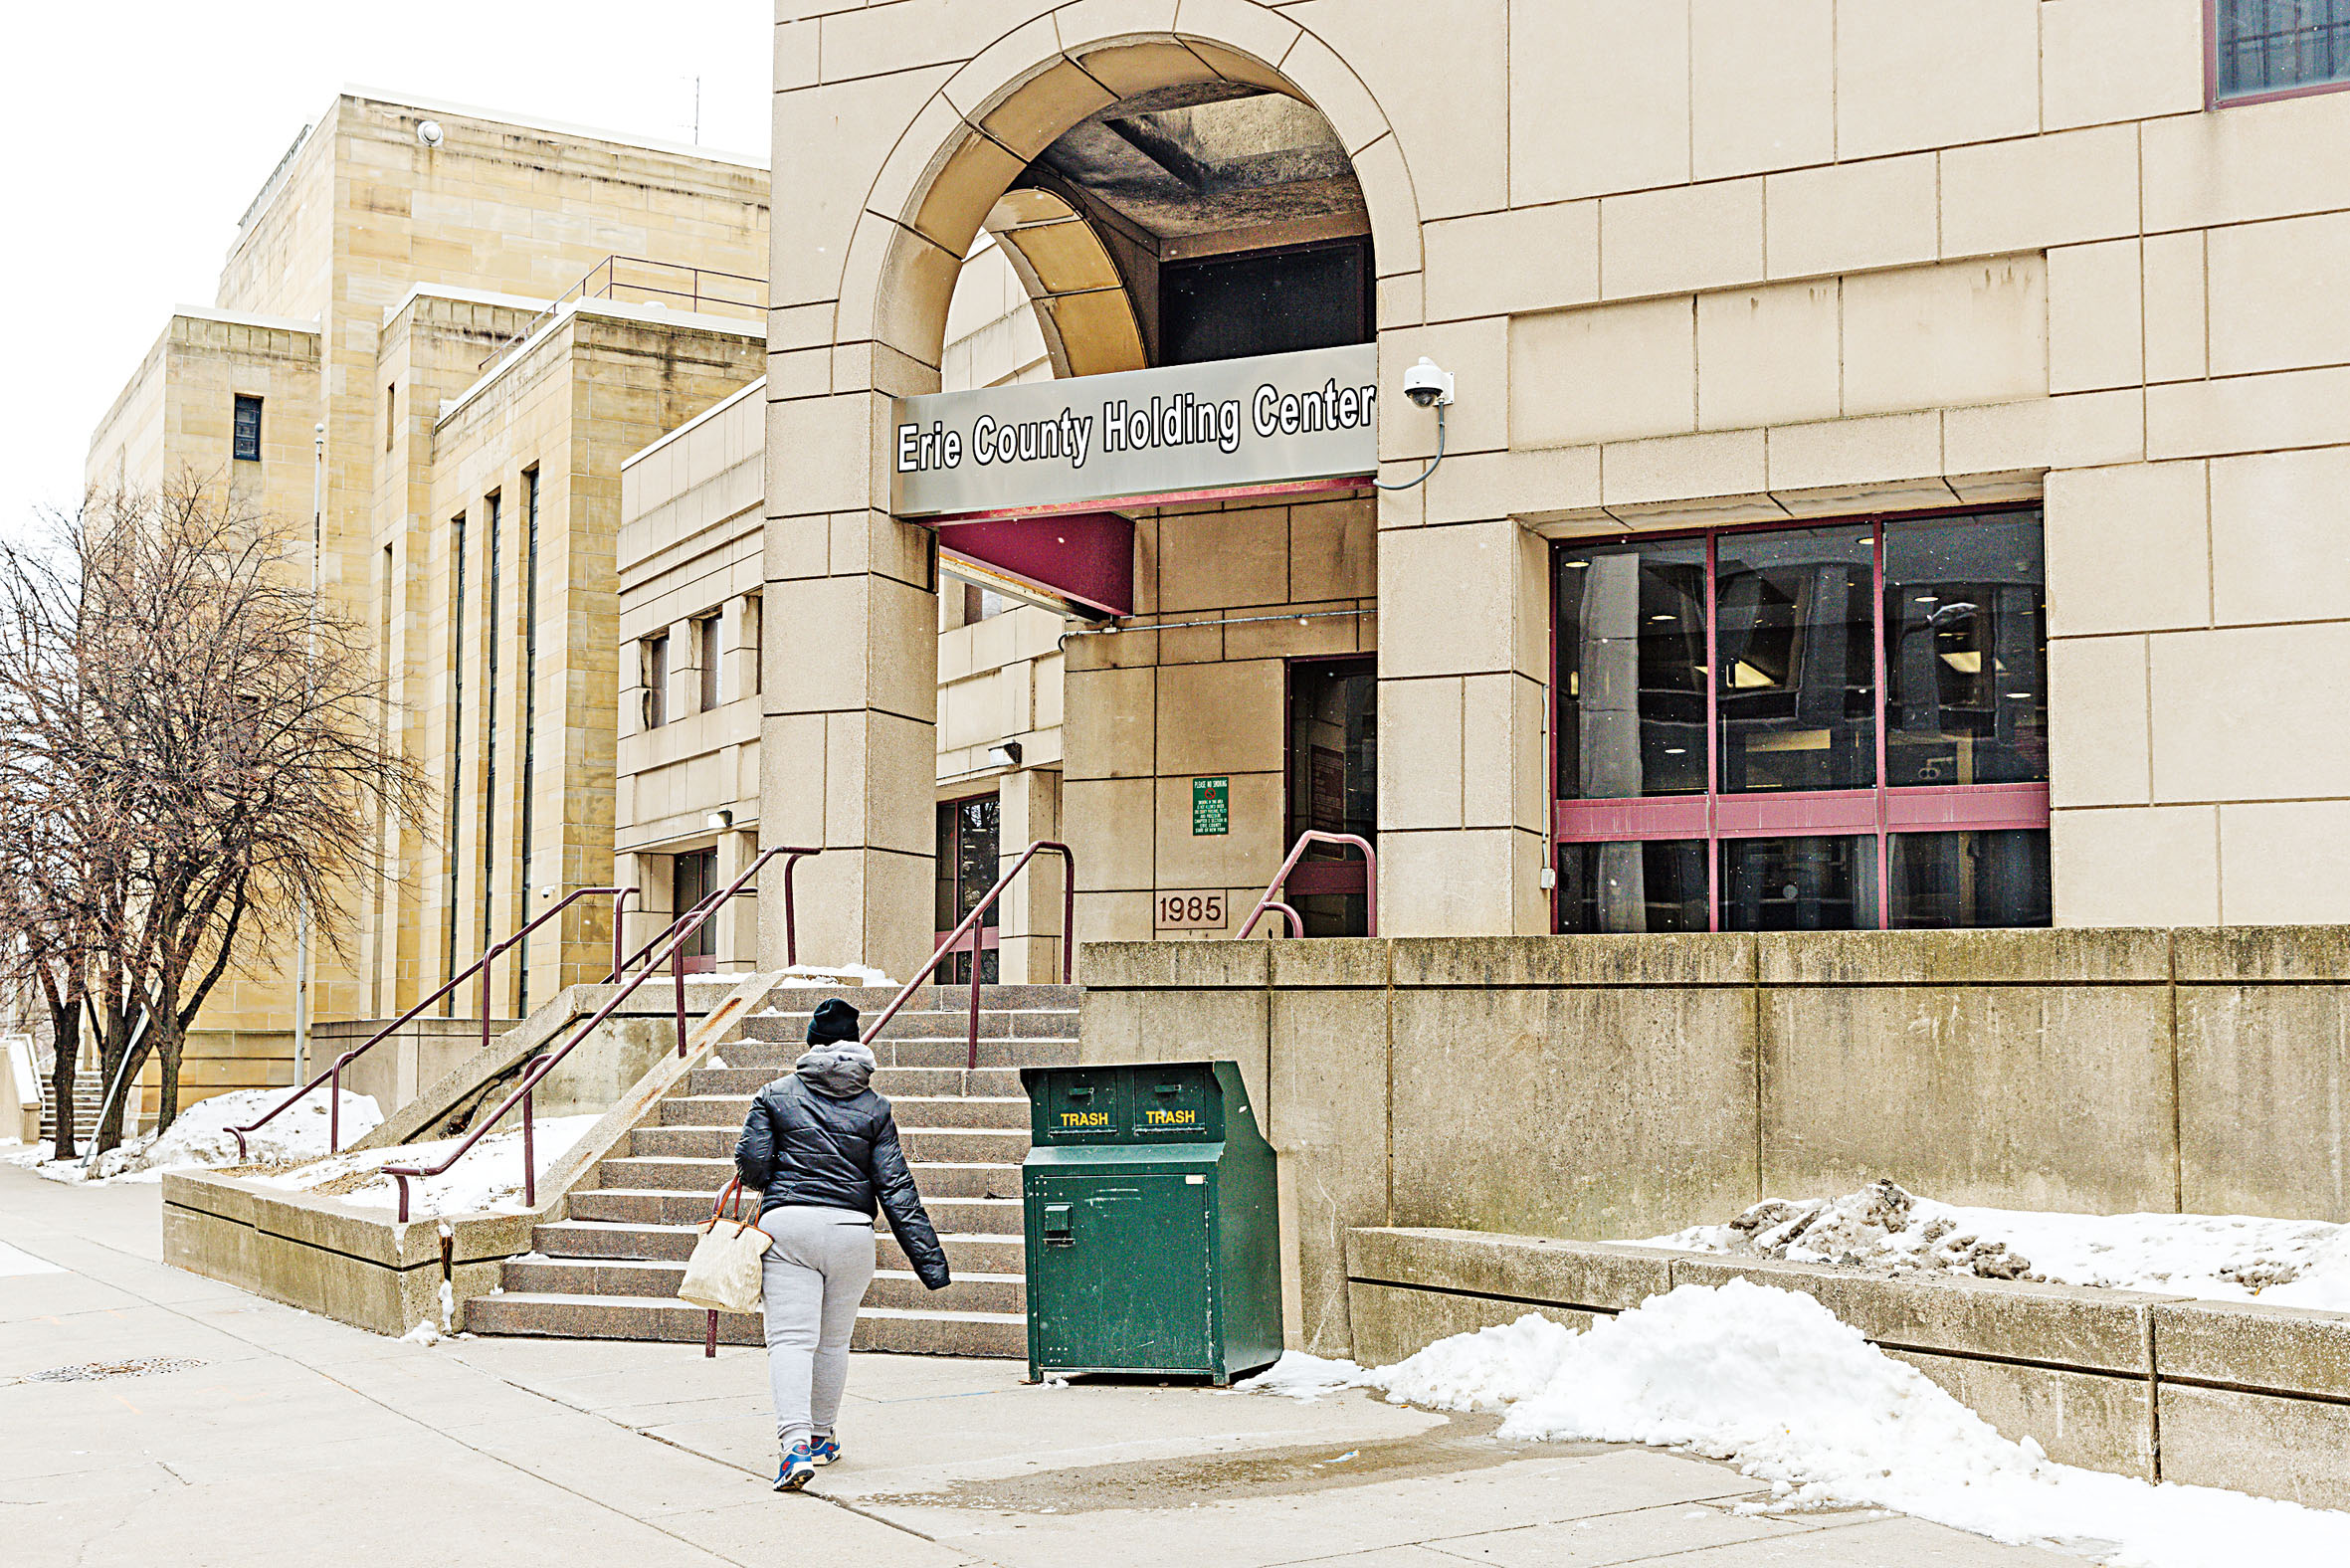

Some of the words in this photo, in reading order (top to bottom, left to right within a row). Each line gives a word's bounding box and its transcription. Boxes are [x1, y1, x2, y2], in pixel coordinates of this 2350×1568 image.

[896, 421, 962, 473] Erie
[972, 407, 1093, 469] County
[1103, 392, 1240, 454] Holding
[1252, 377, 1377, 438] Center
[1160, 896, 1222, 922] 1985
[1061, 1112, 1108, 1126] TRASH
[1146, 1110, 1196, 1124] TRASH
